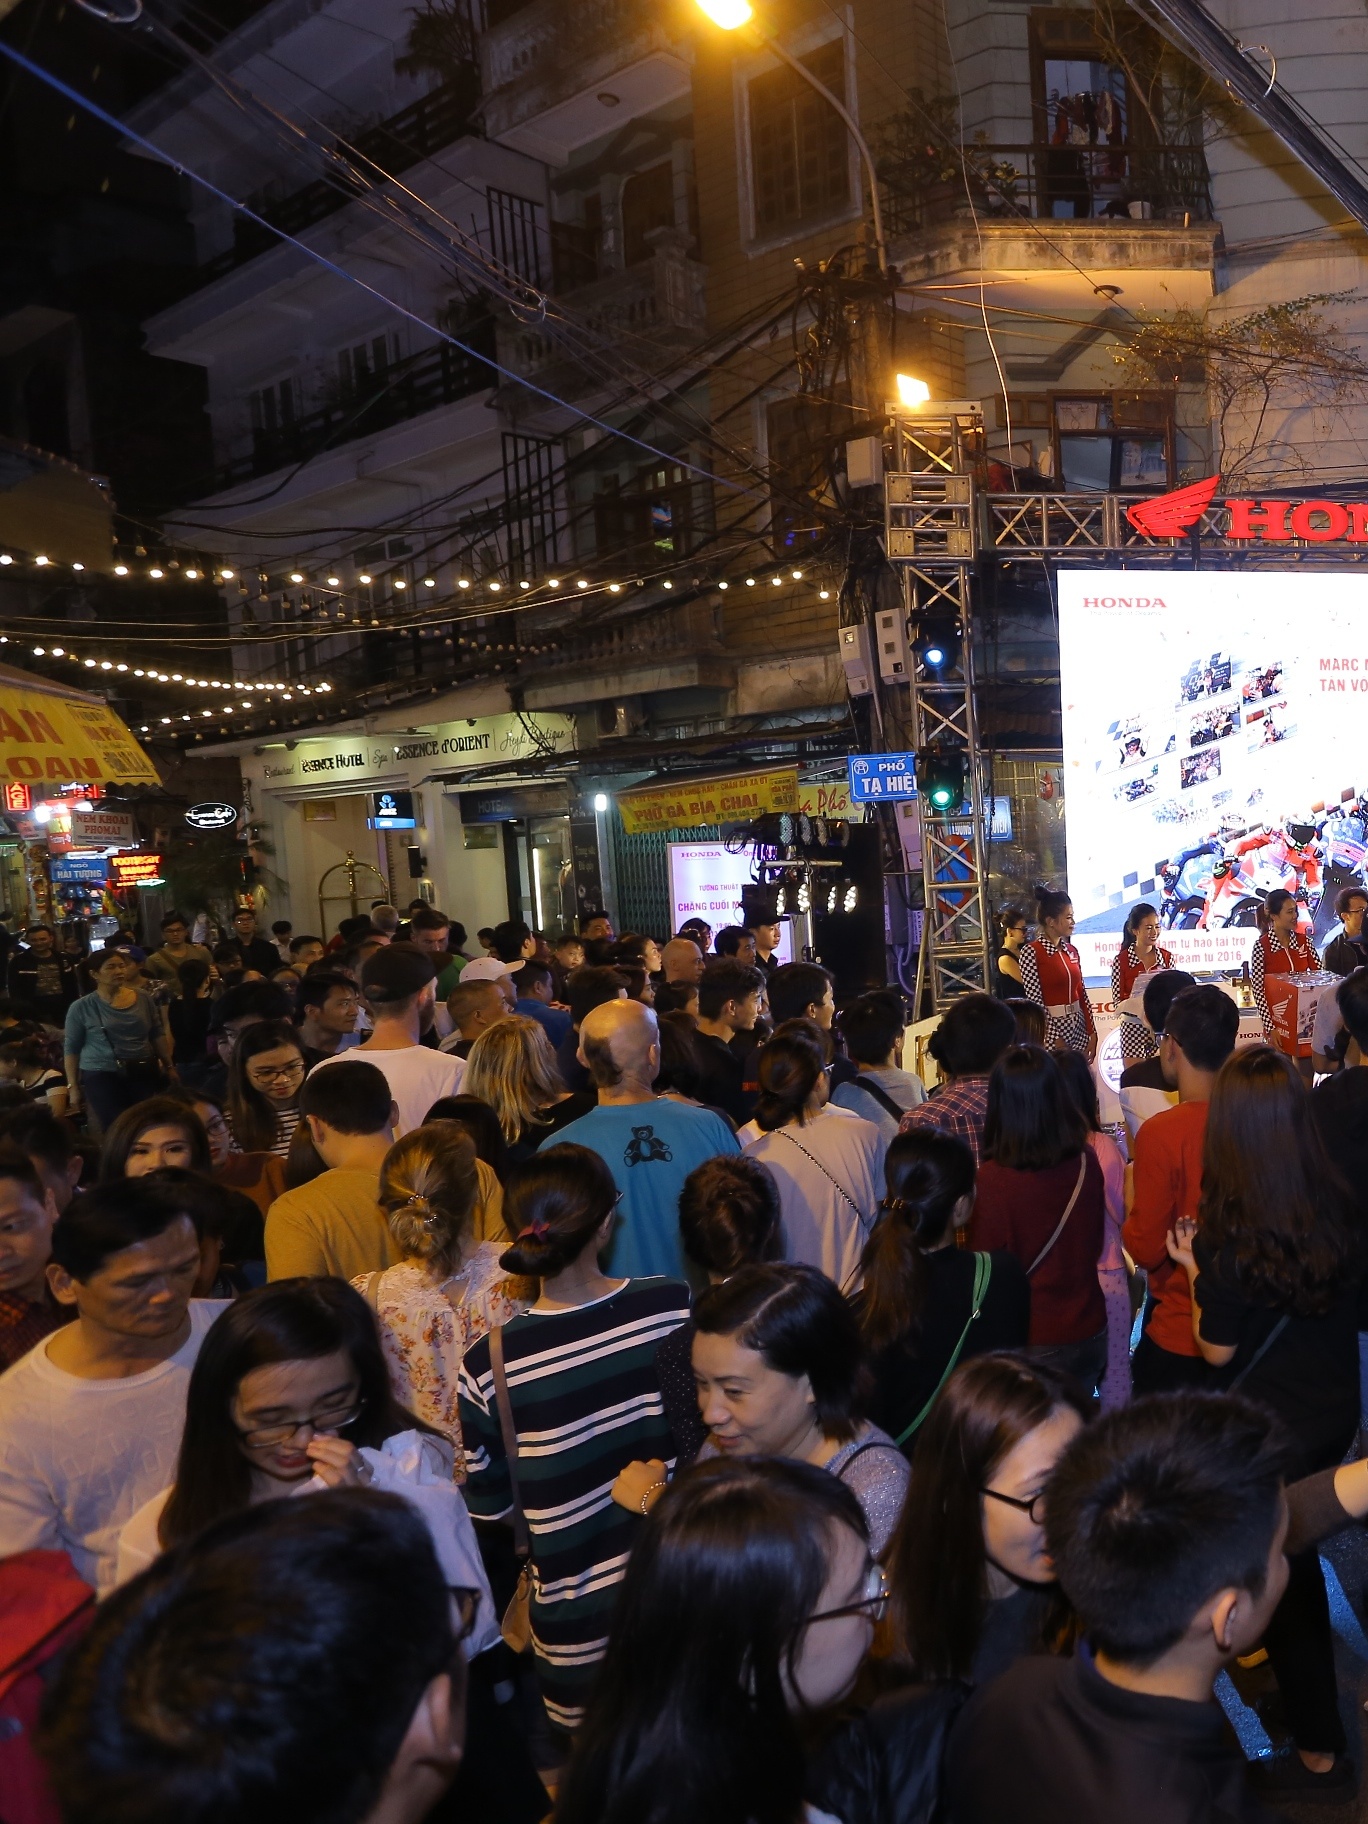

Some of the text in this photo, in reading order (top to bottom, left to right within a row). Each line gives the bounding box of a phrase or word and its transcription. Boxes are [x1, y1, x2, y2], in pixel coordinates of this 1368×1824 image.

[1083, 597, 1167, 608] HONDA
[1320, 658, 1359, 671] MARC
[335, 753, 365, 768] HOTEL
[396, 741, 439, 760] ESSENCE
[0, 756, 103, 779] OAN
[878, 757, 905, 772] PHỐ
[861, 777, 882, 796] TẠ
[666, 801, 687, 818] GÀ
[720, 793, 758, 811] CHAI
[968, 801, 989, 815] PỐ
[76, 813, 129, 825] NEM KHOAI
[84, 824, 121, 835] PHOMAI
[1094, 940, 1122, 953] Hond
[1217, 950, 1242, 962] 2016
